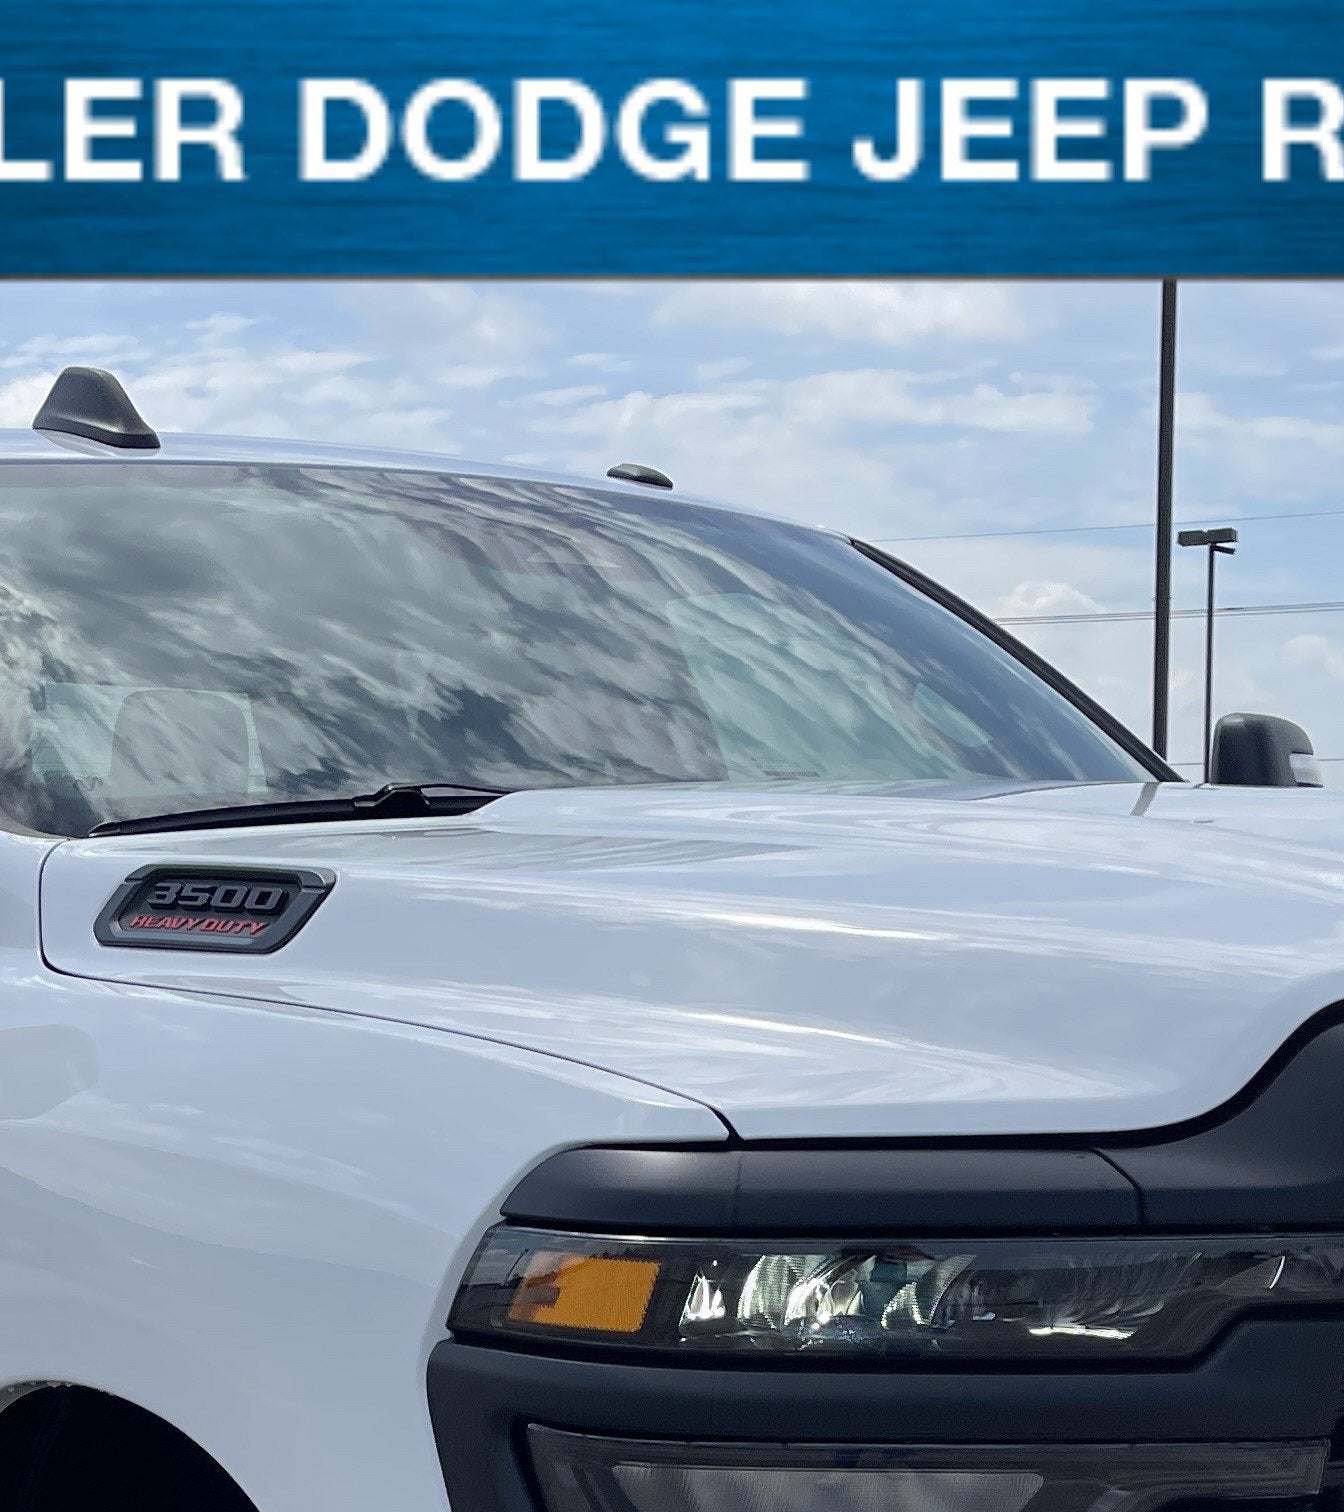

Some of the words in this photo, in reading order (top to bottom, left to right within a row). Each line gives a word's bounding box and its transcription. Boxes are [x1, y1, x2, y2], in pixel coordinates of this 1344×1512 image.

[147, 881, 286, 913] 3500
[129, 915, 201, 932] HEAVY
[199, 918, 271, 935] DUTY
